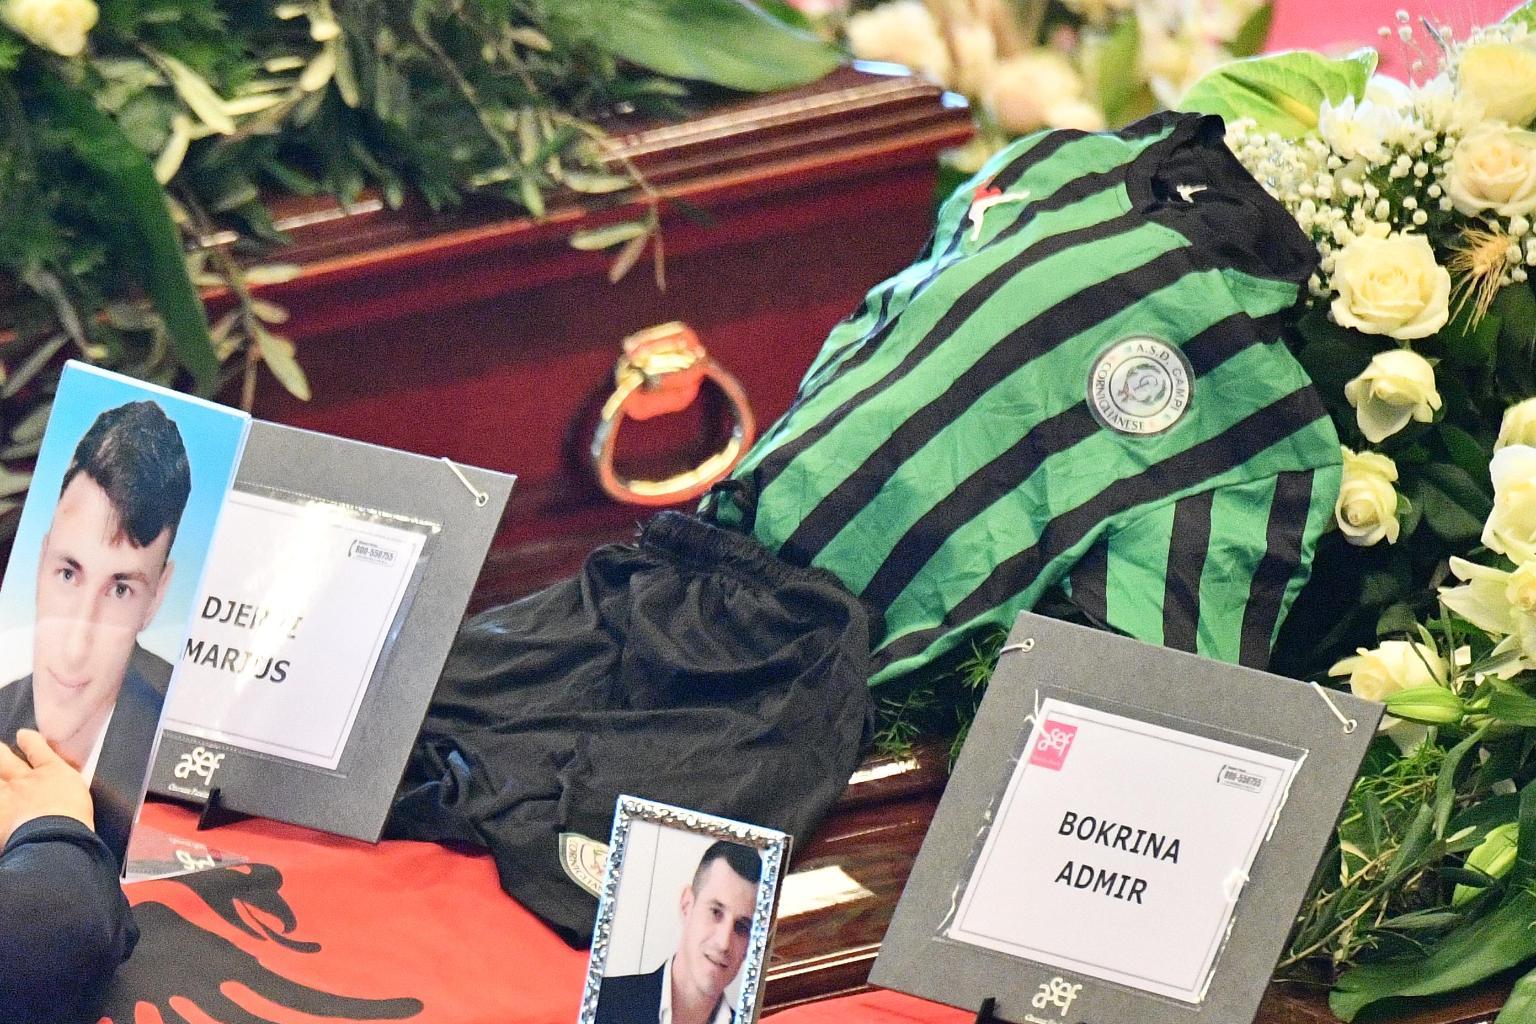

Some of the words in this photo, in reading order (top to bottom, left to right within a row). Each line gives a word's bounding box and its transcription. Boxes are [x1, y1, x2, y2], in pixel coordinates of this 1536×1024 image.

[1170, 367, 1185, 412] CAMPI
[1058, 811, 1180, 865] BOKRINA
[1054, 860, 1148, 905] ADMIR
